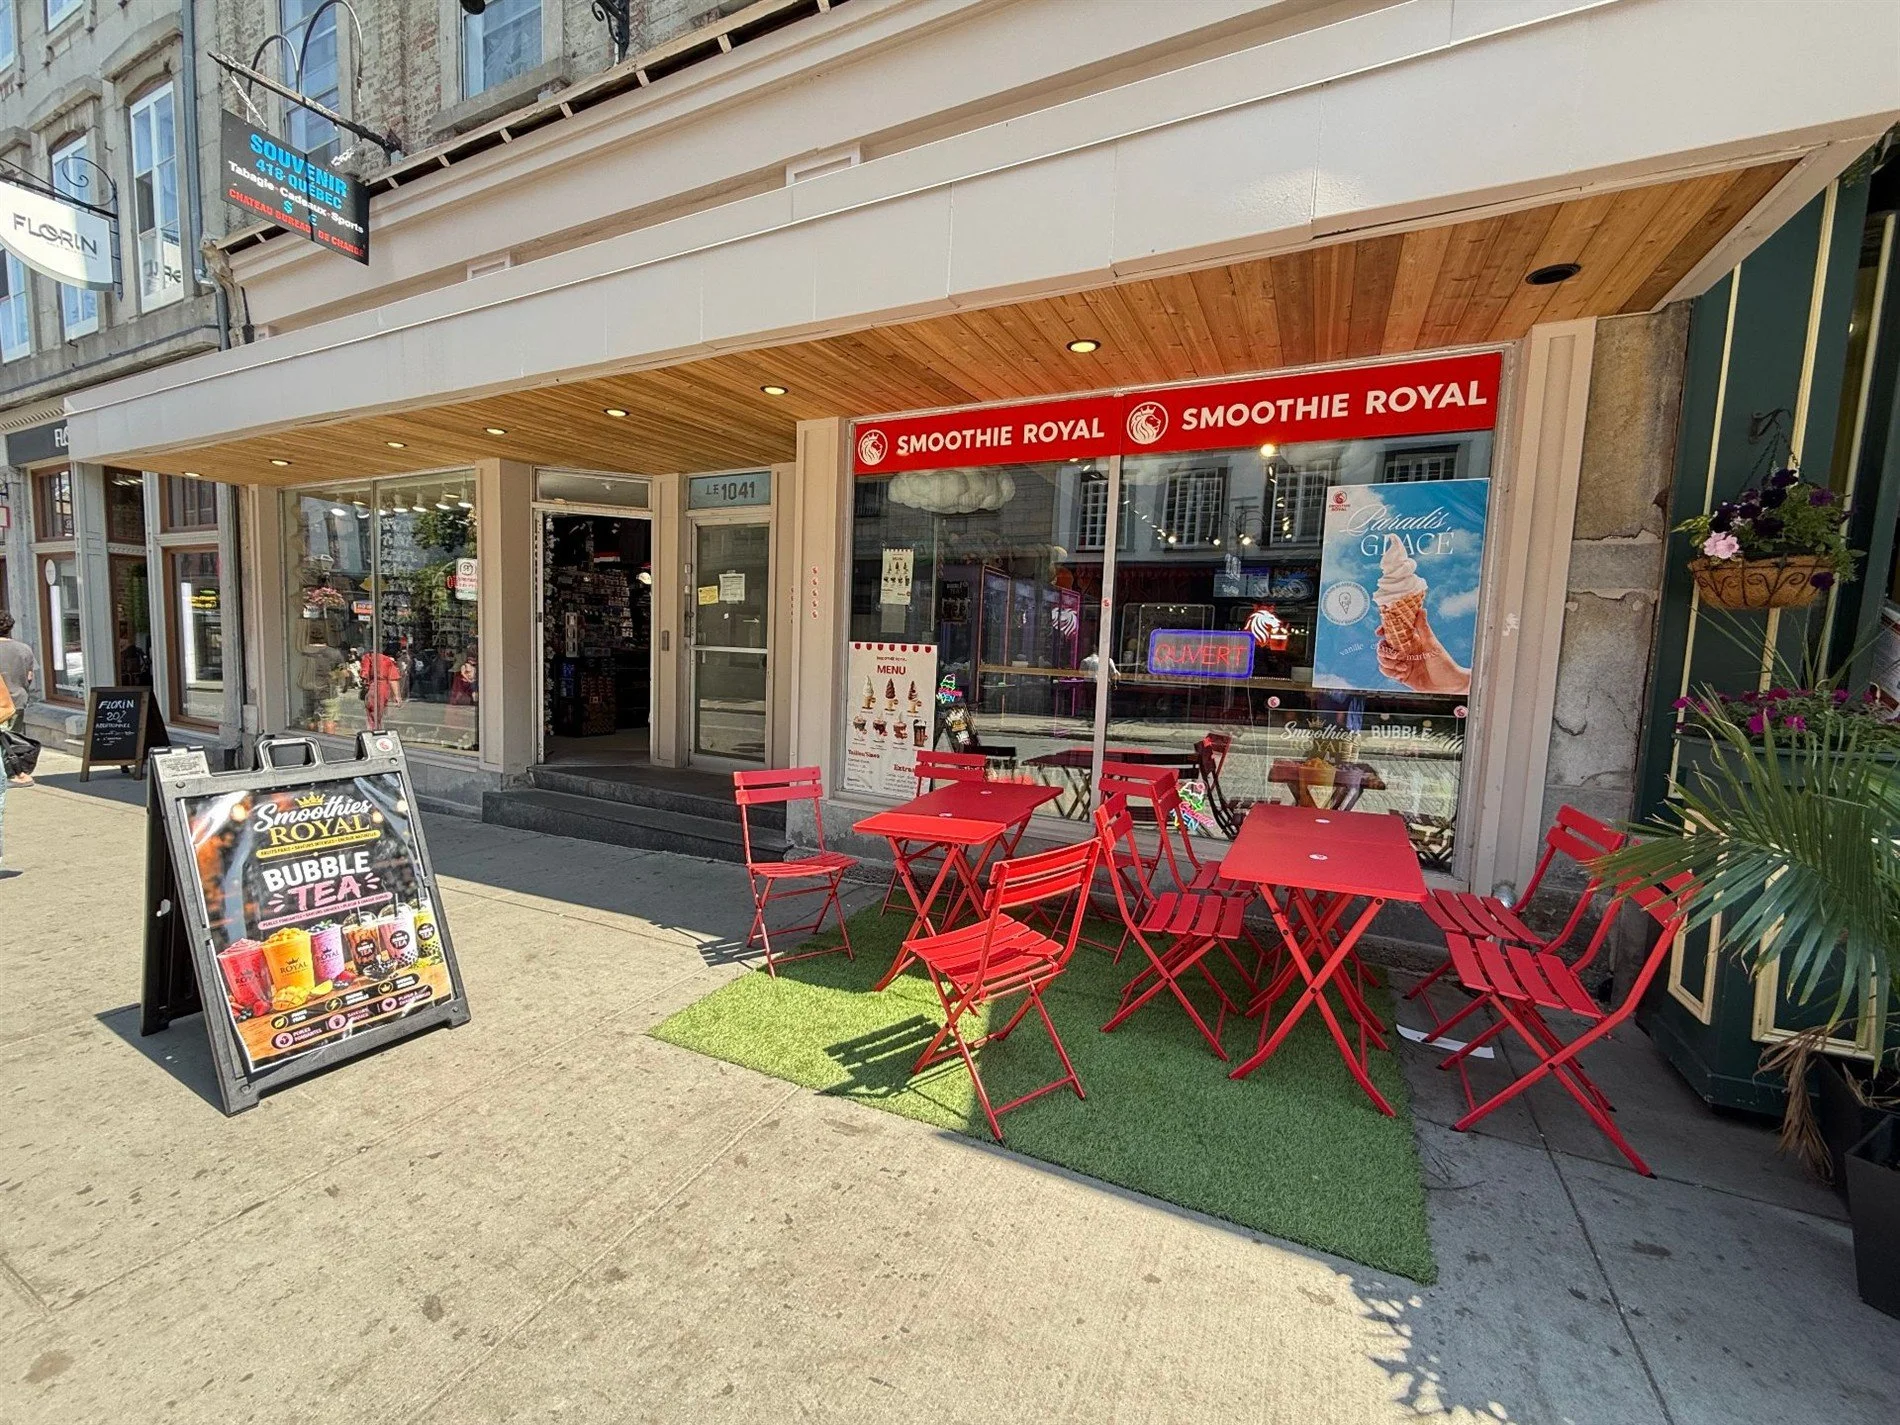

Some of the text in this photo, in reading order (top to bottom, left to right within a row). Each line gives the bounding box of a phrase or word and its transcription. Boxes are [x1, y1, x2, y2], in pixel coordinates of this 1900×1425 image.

[250, 133, 348, 198] SOUVENIR
[256, 159, 284, 181] 418
[228, 160, 364, 234] Tabagie Cadeaux Sports
[12, 212, 97, 256] FLORIN
[1181, 380, 1487, 431] SMOOTHIE ROYAL
[897, 417, 1105, 455] SMOOTHIE ROYAL
[705, 481, 755, 500] LE 1041
[1339, 504, 1450, 535] Paradis
[1154, 642, 1248, 666] OUVERT
[877, 665, 906, 675] MENU
[99, 699, 135, 710] FLORIN
[253, 795, 373, 832] Smoothies
[268, 814, 370, 846] ROYAL
[262, 851, 371, 893] BUBBLE
[288, 875, 361, 912] TEA
[360, 948, 373, 956] TEA
[393, 939, 407, 948] TEA
[280, 961, 308, 974] ROYAL
